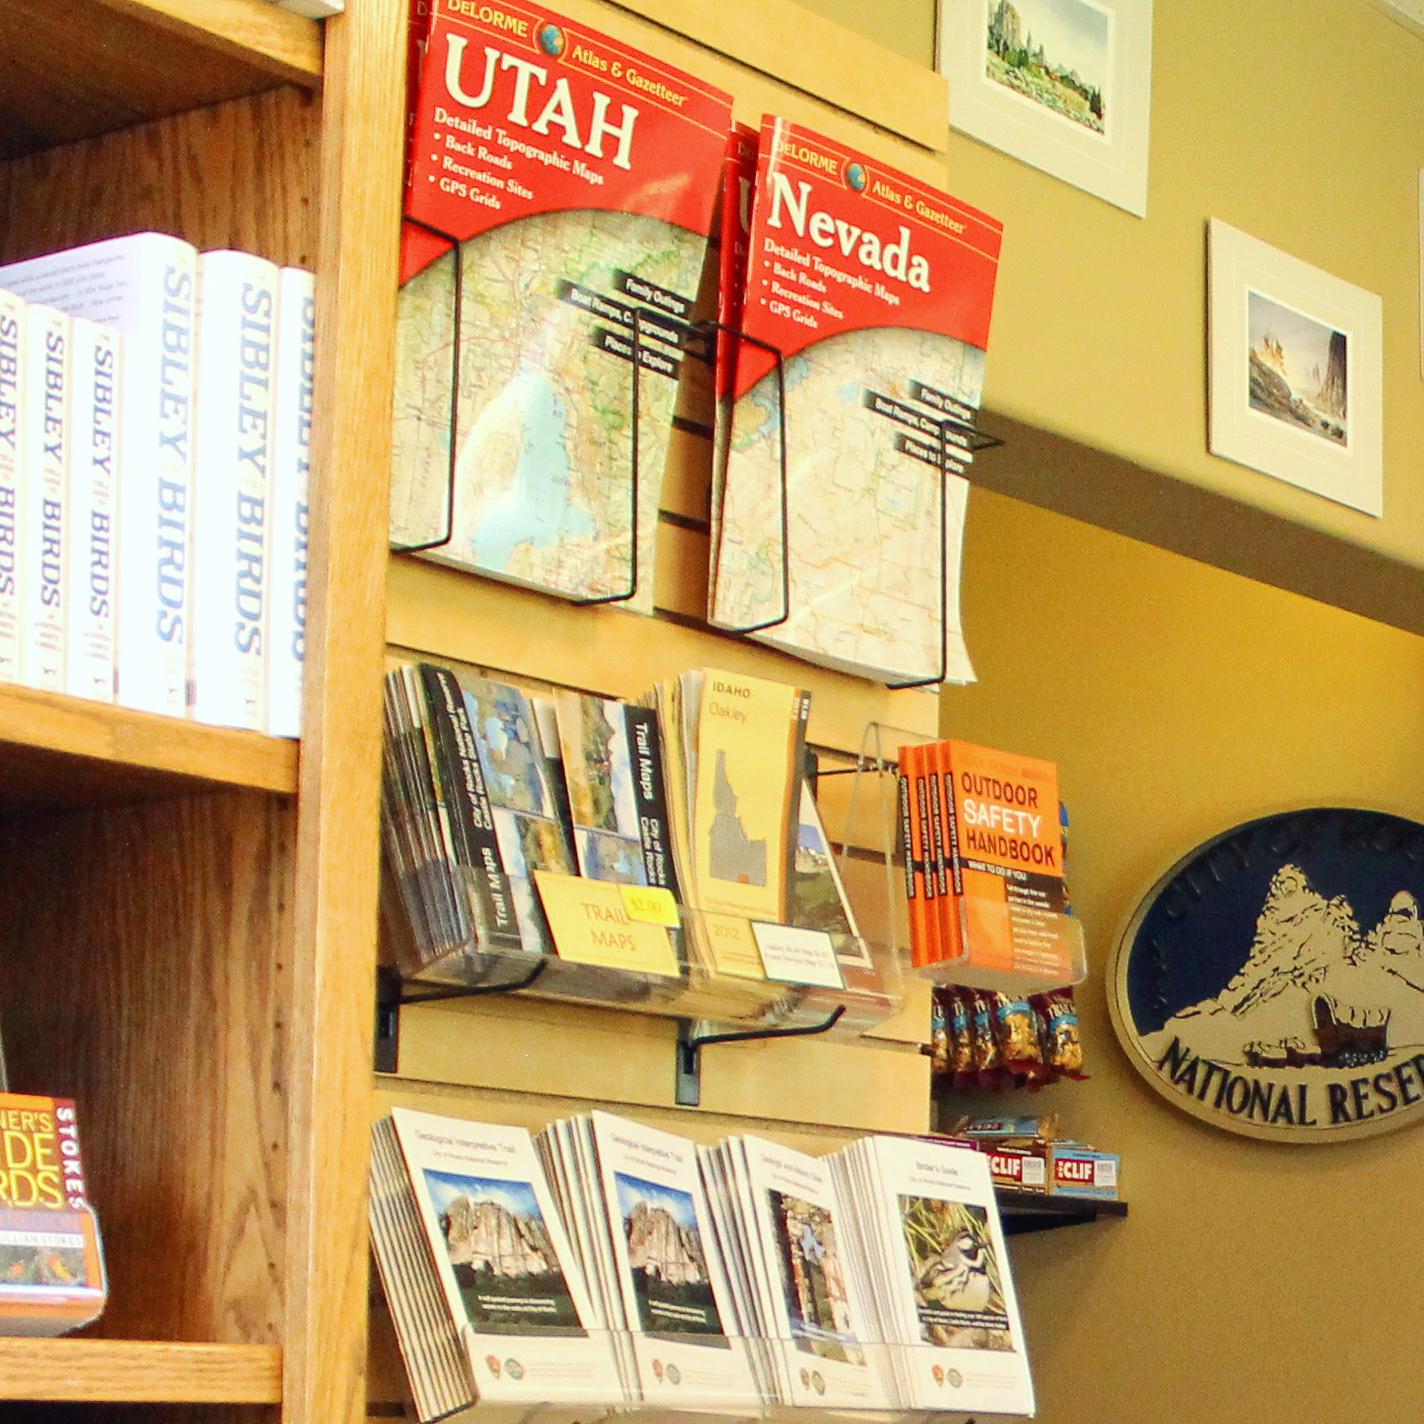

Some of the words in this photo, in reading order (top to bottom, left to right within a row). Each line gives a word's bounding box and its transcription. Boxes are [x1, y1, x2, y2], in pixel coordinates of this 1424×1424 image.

[571, 45, 607, 72] Atlas
[611, 62, 624, 77] &
[626, 68, 686, 107] Gazetteer
[445, 33, 639, 170] UTAH
[434, 107, 492, 140] Detailed
[496, 128, 570, 171] Topographic
[572, 161, 604, 185] Maps
[445, 134, 475, 156] Back
[477, 148, 513, 170] Roads
[440, 177, 467, 198] GPS
[469, 188, 501, 209] Grids
[443, 157, 504, 189] Recreation
[507, 181, 534, 200] Sites
[872, 181, 901, 205] Atlas
[903, 196, 914, 209] &
[916, 202, 965, 234] Gazetteer
[767, 172, 931, 293] Nevada
[764, 238, 811, 267] Detailed
[813, 258, 872, 293] Topographic
[874, 285, 900, 306] Maps
[773, 262, 797, 282] Back
[799, 273, 827, 294] Roads
[769, 301, 791, 318] GPS
[792, 311, 818, 328] Grids
[771, 282, 820, 310] Recreation
[822, 302, 844, 319] Sites
[158, 264, 193, 471] SIBLEY
[236, 281, 273, 484] SIBLEY
[44, 329, 64, 464] SIBLEY
[91, 343, 114, 478] SIBLEY
[41, 497, 62, 608] BIRDS
[89, 509, 111, 618] BIRDS
[154, 476, 188, 646] BIRDS
[233, 490, 267, 656] BIRDS
[712, 680, 751, 699] IDAHO
[709, 702, 749, 725] Oakley
[635, 722, 651, 756] Trail
[639, 758, 654, 801] Maps
[961, 772, 1038, 809] OUTDOOR
[963, 798, 1042, 839] SAFETY
[481, 847, 503, 888] Maps
[966, 829, 1056, 867] HANDBOOK
[494, 888, 510, 928] Trail
[580, 902, 630, 926] TRAIL
[590, 927, 637, 952] MAPS
[1156, 1036, 1318, 1127] NATIONAL
[57, 1106, 85, 1210] STOKES
[991, 1156, 1021, 1176] CLIF
[1063, 1161, 1092, 1180] CLIF
